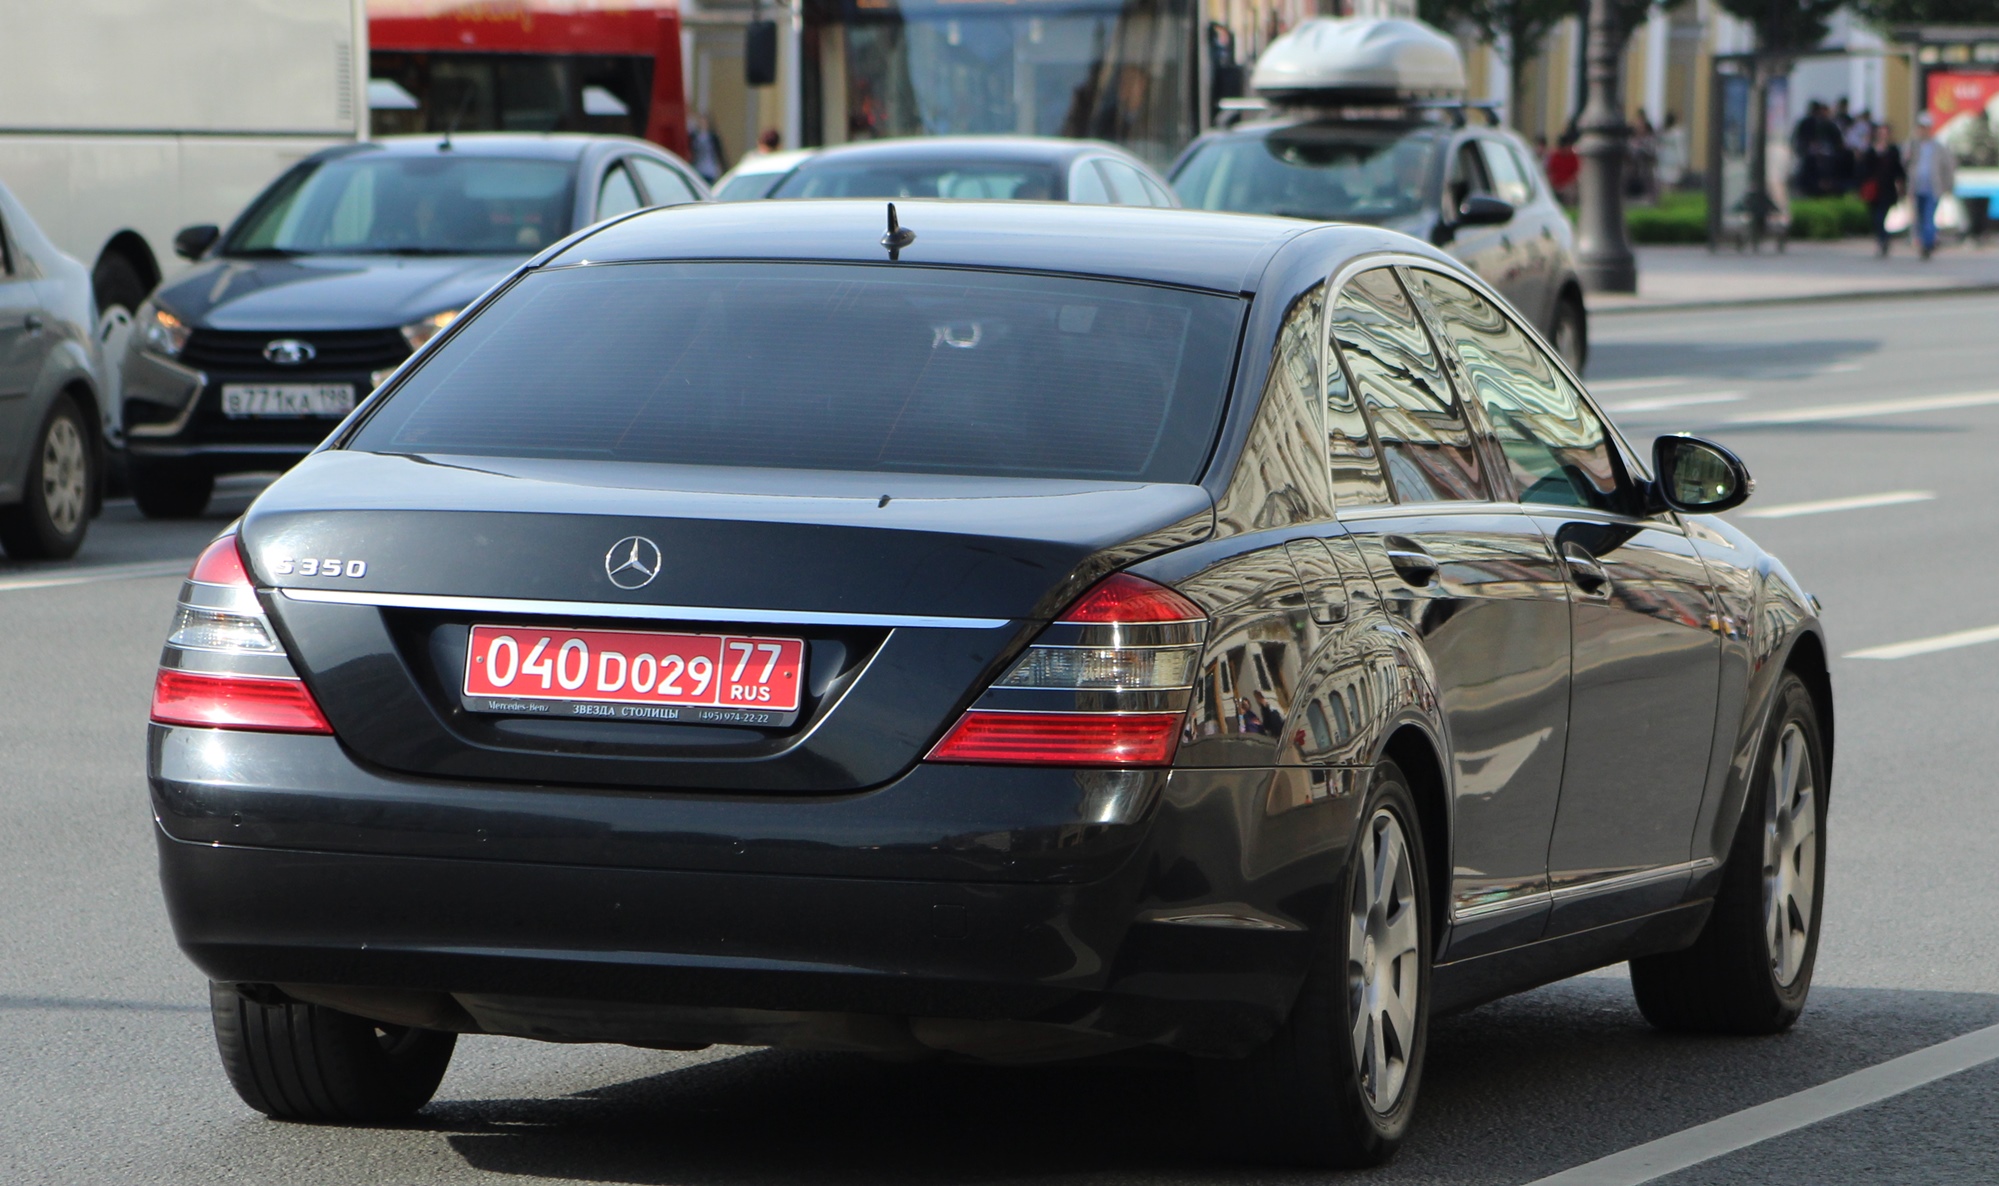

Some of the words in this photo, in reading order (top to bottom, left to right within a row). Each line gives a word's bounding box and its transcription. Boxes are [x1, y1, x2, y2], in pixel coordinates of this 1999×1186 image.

[729, 641, 782, 684] 77
[730, 684, 771, 702] RUS
[488, 701, 549, 713] Mercedes-Benz
[573, 705, 615, 716] ЗВЕЗДА
[621, 707, 679, 719] СТОЛИЦЫ
[699, 711, 723, 720] (495)
[724, 711, 769, 723] 974-22-22
